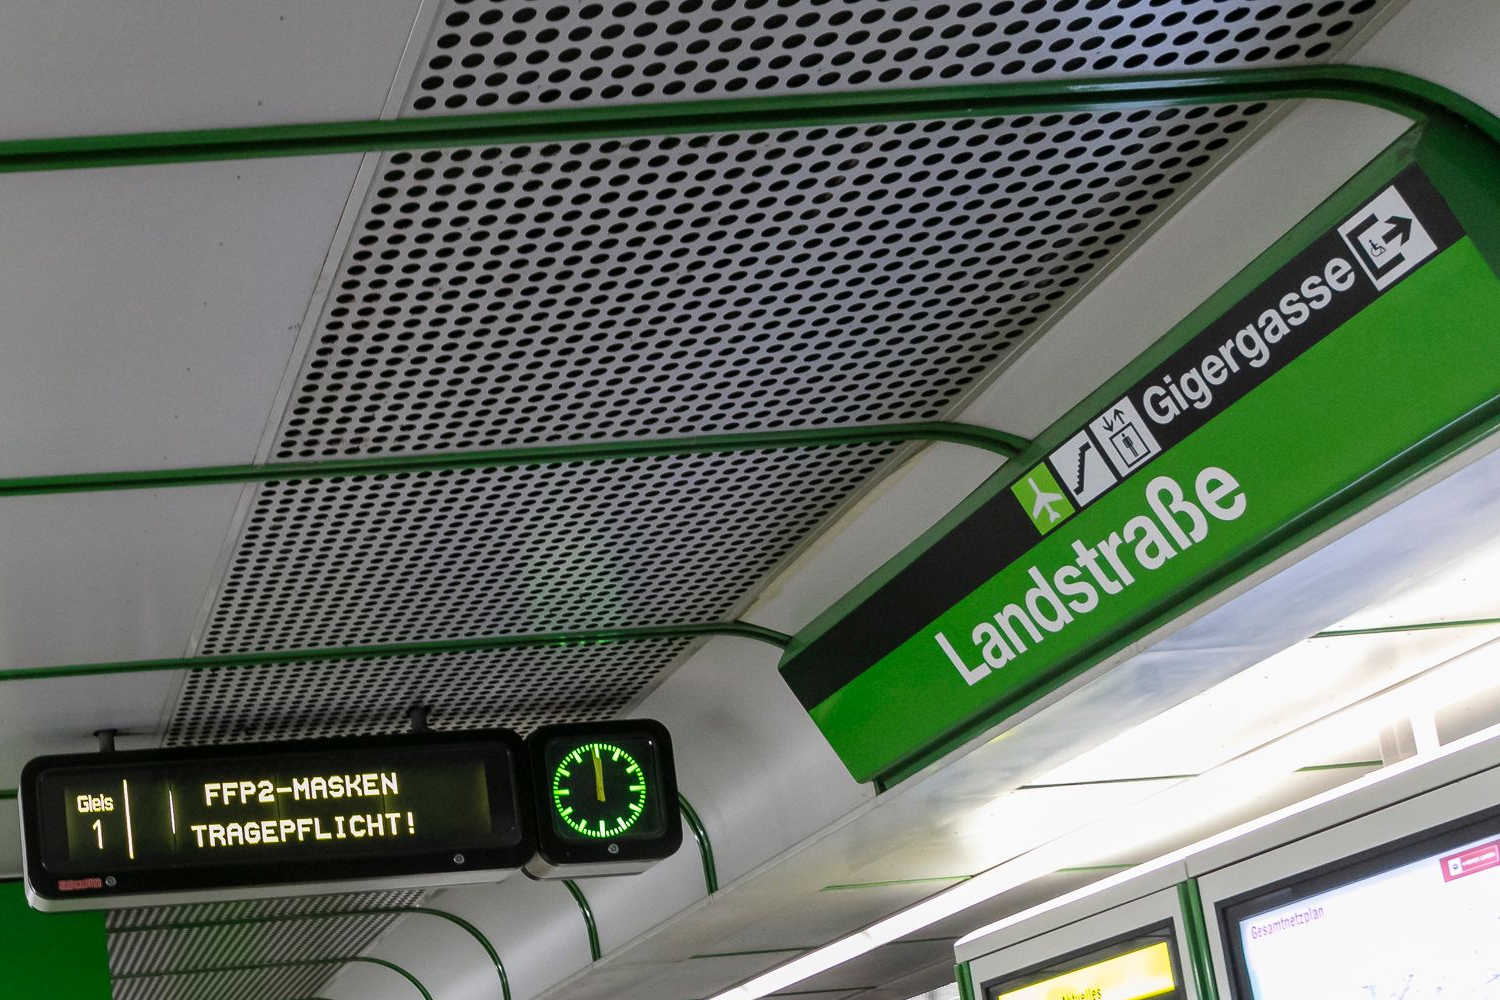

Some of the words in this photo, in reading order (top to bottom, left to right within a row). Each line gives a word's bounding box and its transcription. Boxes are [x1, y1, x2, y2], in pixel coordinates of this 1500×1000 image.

[1142, 256, 1356, 425] Gigergasse
[934, 466, 1247, 686] Landstraße
[76, 793, 114, 813] Gleis
[204, 772, 399, 806] FFP2-MASKEN
[92, 818, 104, 850] 1
[191, 811, 415, 848] TRAGEPFLICHT!
[1251, 905, 1325, 940] Gesamtnetzplan
